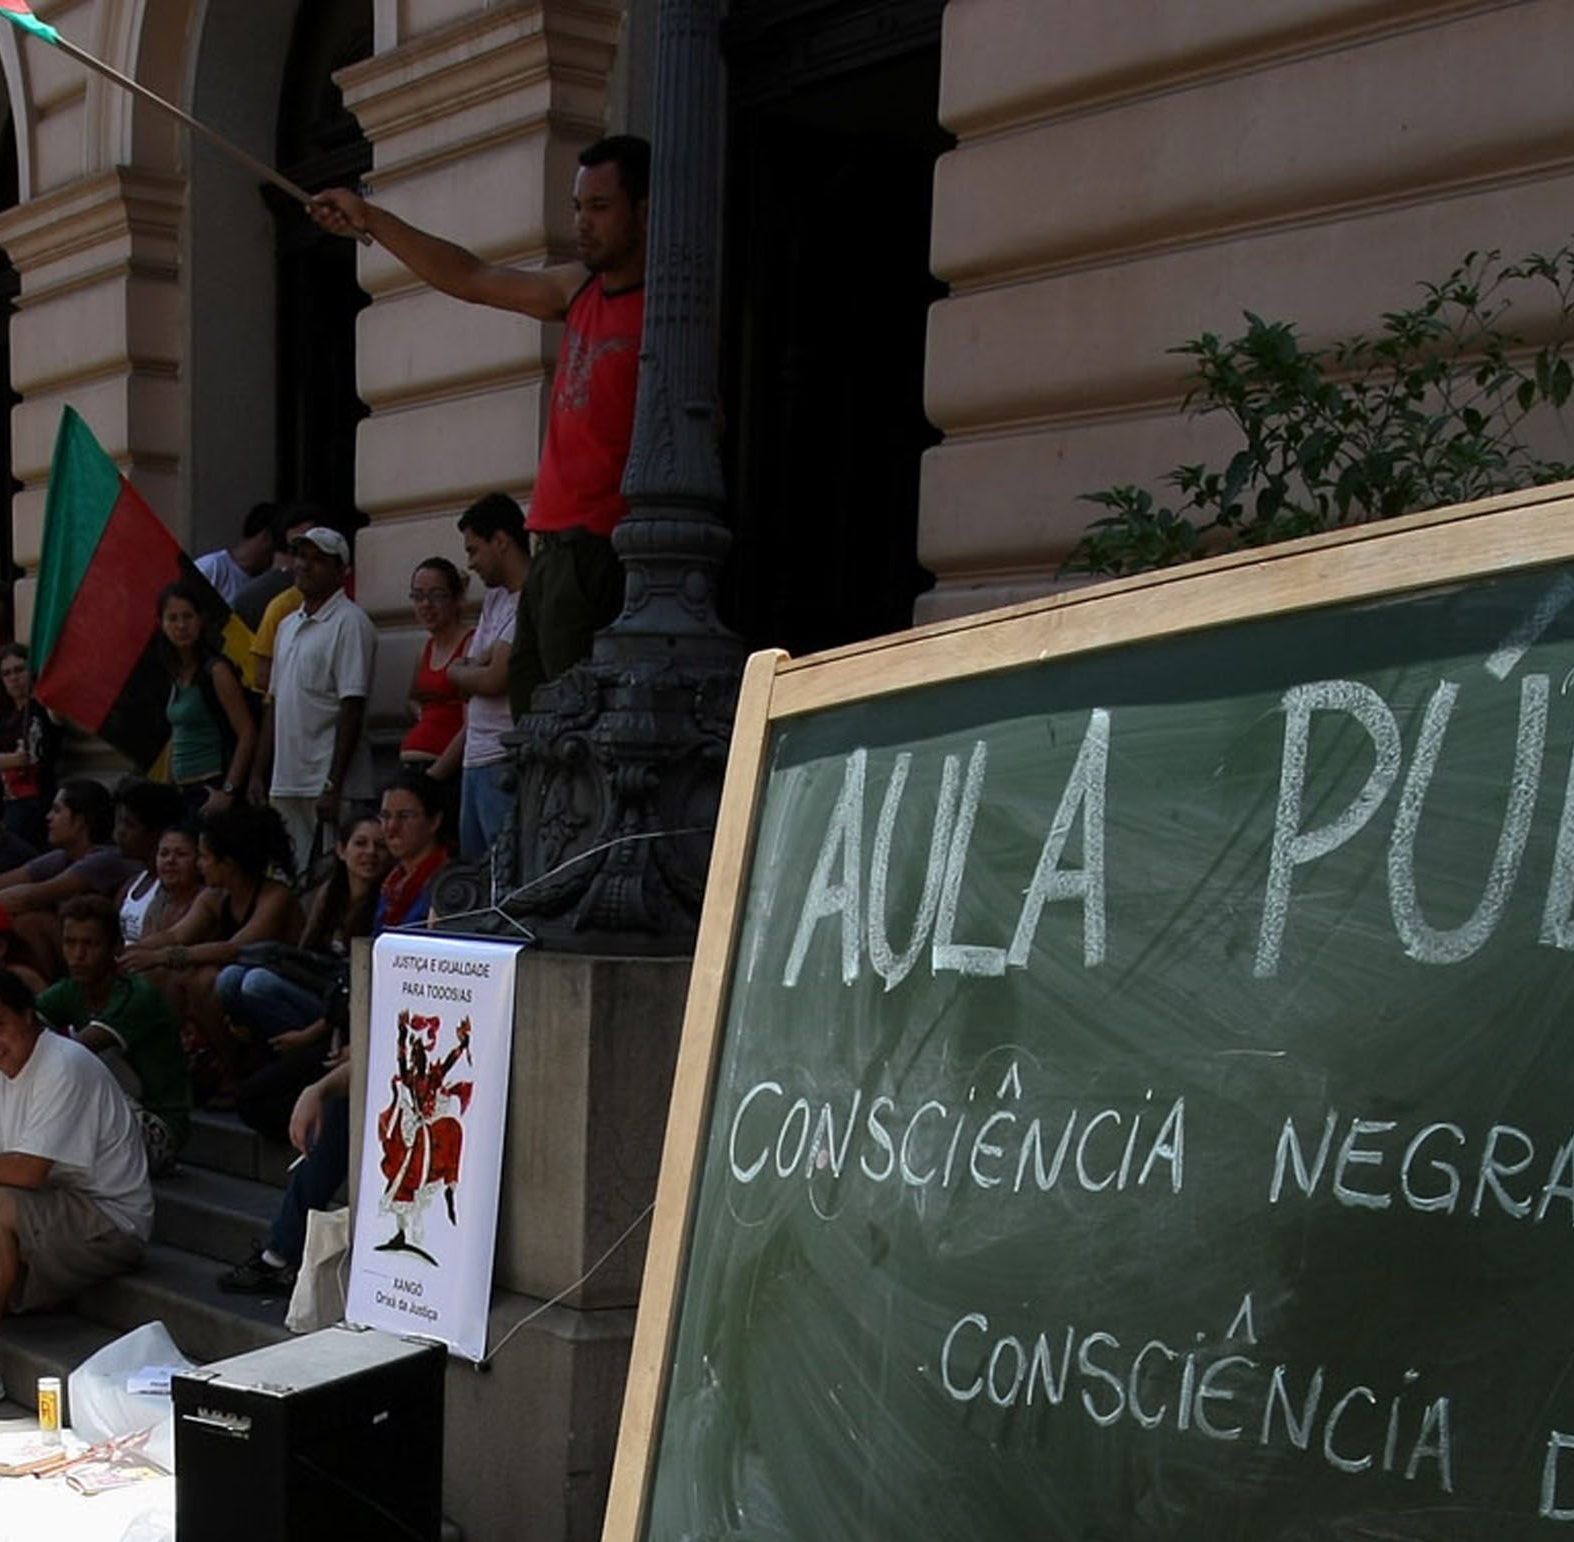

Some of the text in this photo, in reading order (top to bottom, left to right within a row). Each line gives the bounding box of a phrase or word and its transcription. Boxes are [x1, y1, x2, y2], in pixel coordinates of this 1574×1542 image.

[782, 707, 1110, 992] AULA
[392, 956, 490, 978] JUSTIÇA E IGUALDADE
[403, 981, 425, 997] PARA
[728, 1061, 1185, 1193] CONSCIÊNCIA
[940, 1292, 1453, 1493] CONSCIÊNCIA
